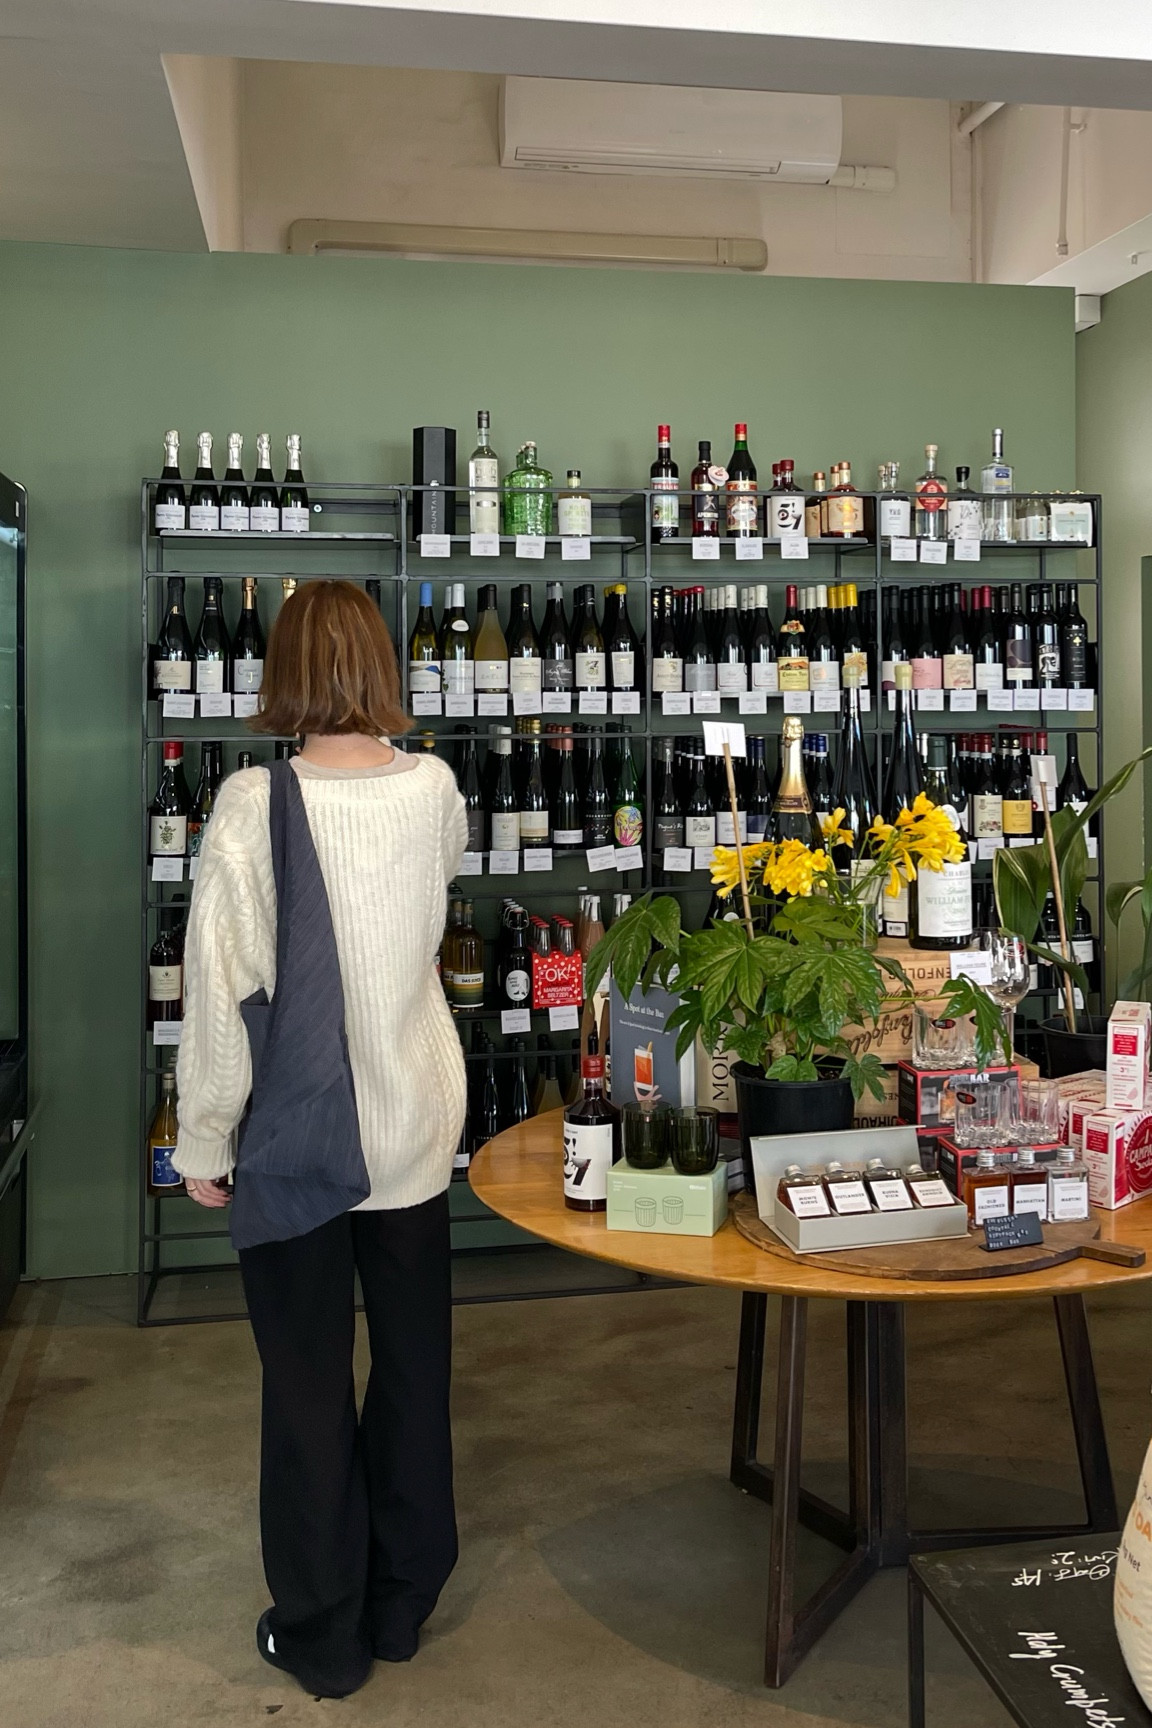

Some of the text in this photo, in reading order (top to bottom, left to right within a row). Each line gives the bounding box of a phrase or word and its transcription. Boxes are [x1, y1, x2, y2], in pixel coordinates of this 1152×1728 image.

[545, 964, 572, 982] OK!
[543, 986, 573, 994] MARGARITA
[628, 1003, 641, 1014] Spot
[646, 1007, 655, 1017] the
